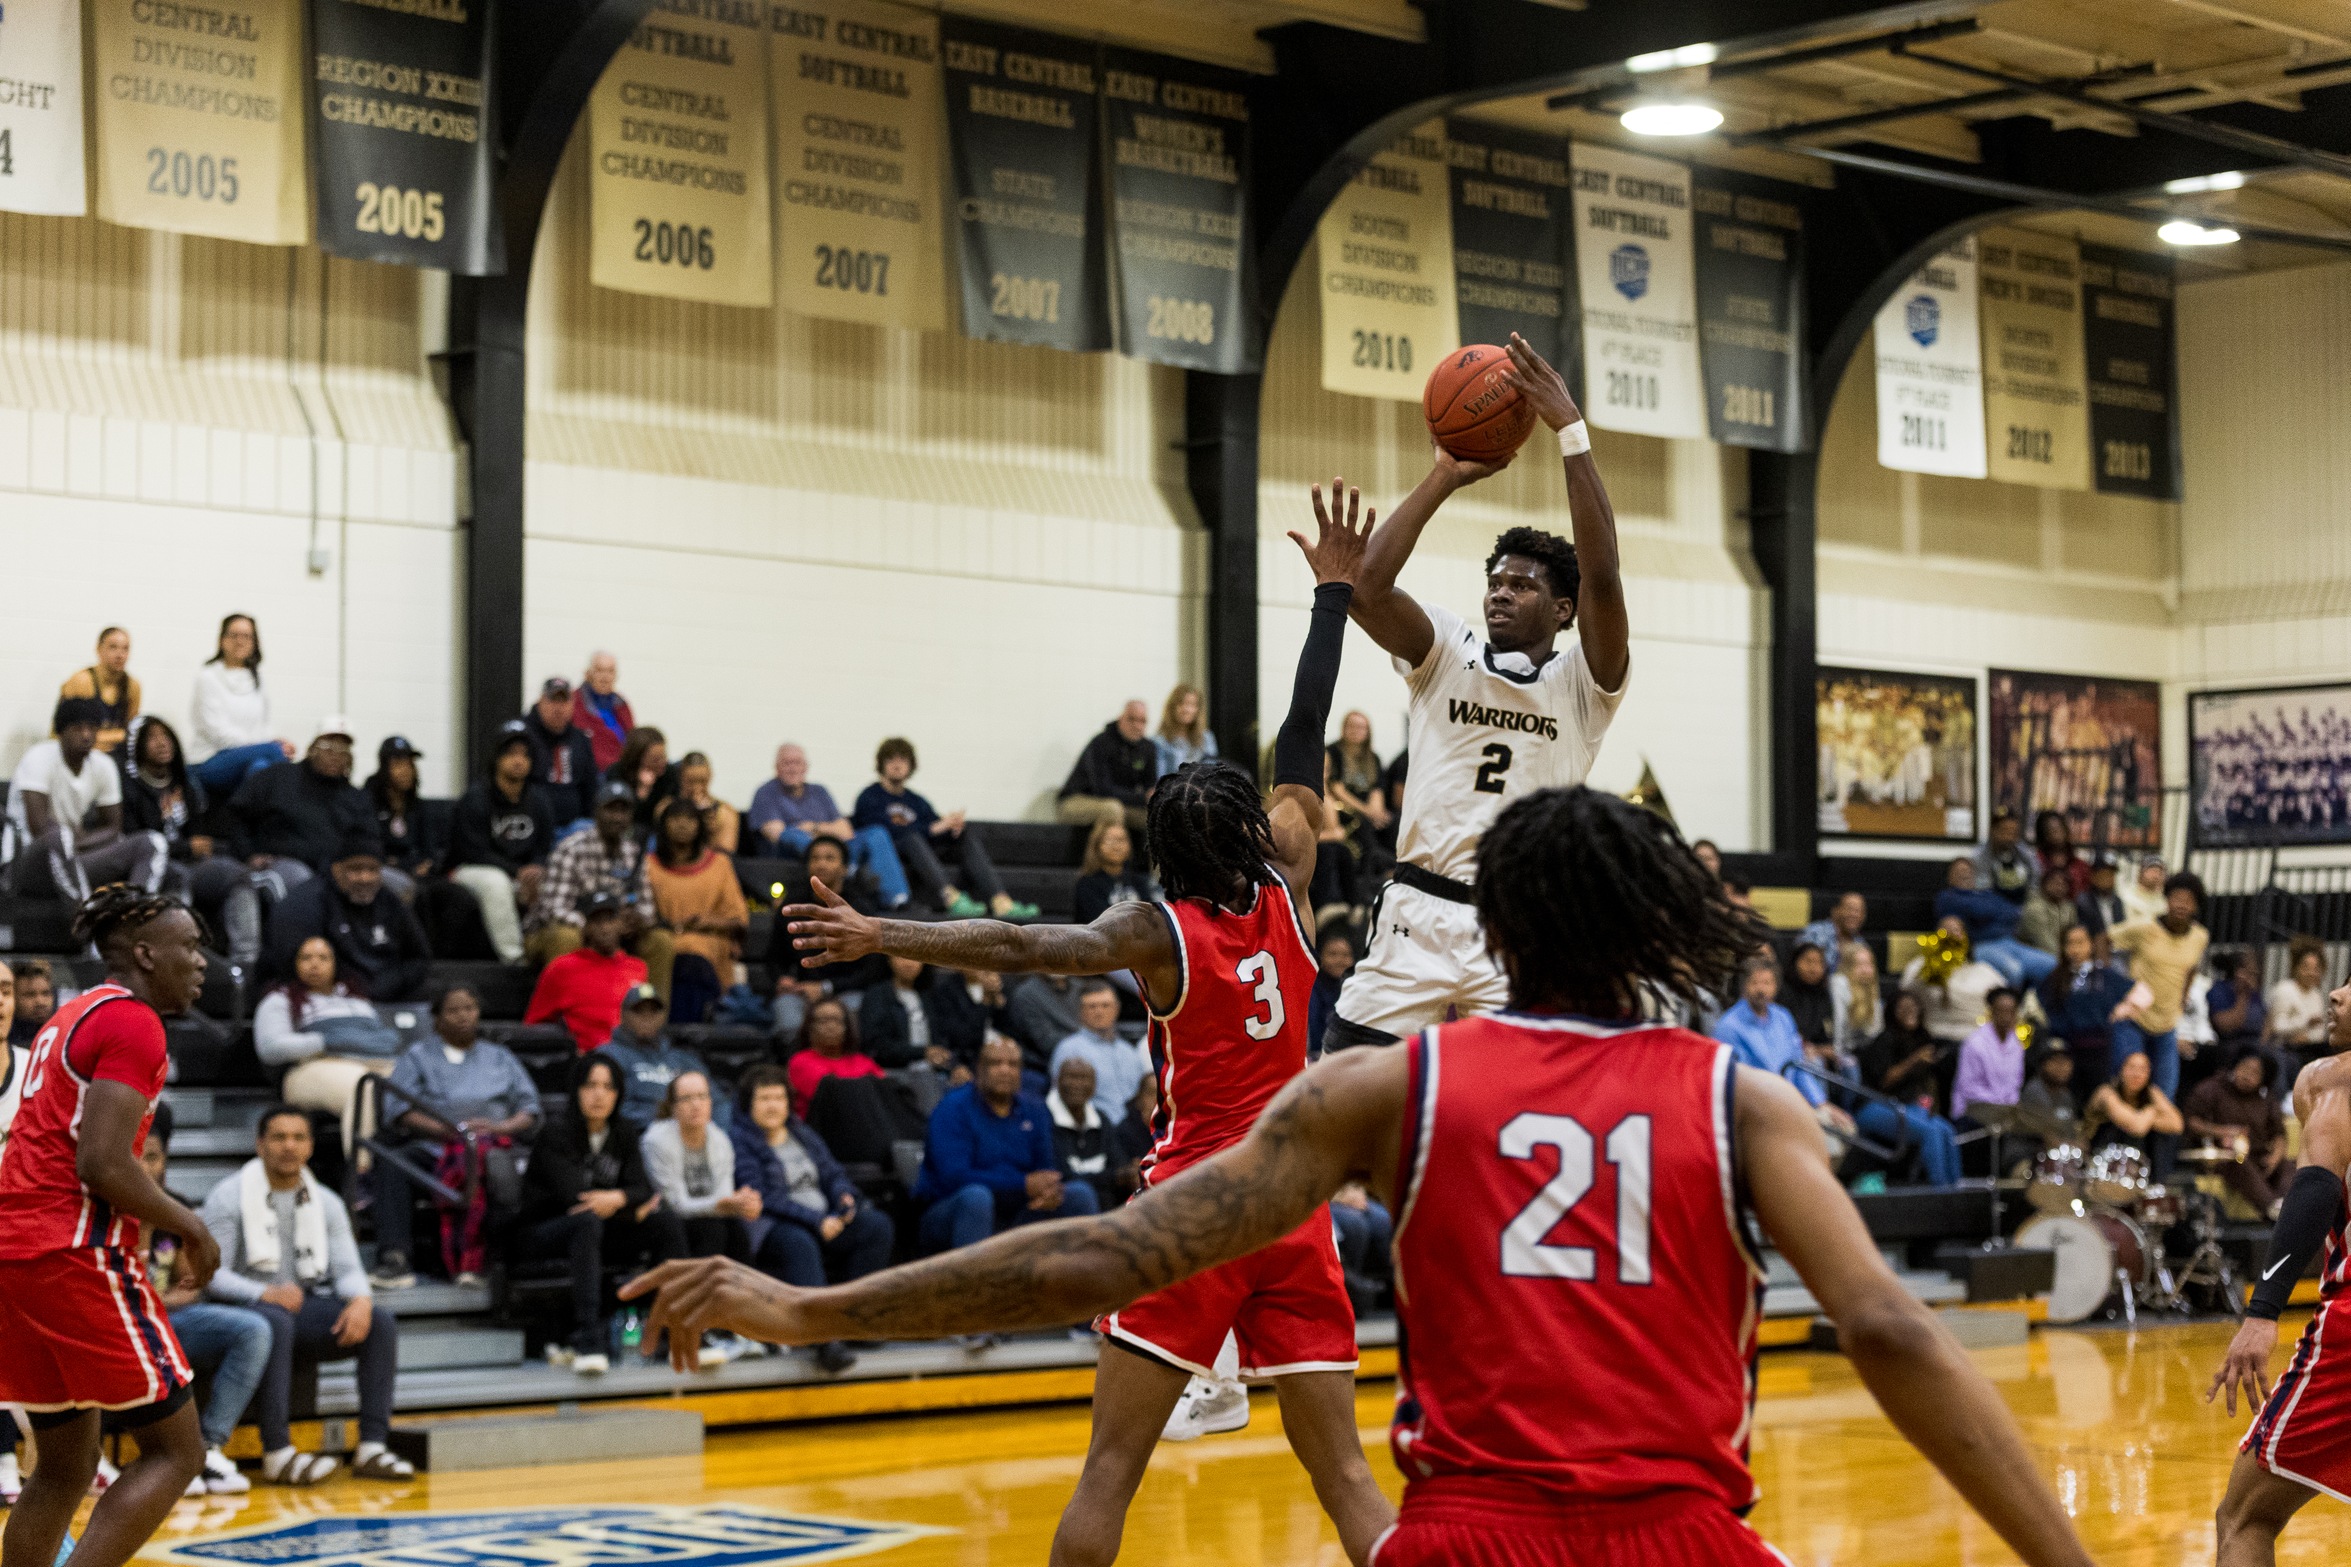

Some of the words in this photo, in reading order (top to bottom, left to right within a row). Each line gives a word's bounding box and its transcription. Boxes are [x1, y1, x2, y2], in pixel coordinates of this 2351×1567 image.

[131, 0, 260, 42] CENTRAL
[772, 7, 828, 41] EAST
[837, 21, 935, 63] CENTRAL
[133, 36, 257, 81] DIVISION
[316, 53, 421, 95] REGION
[799, 53, 911, 99] SOFTBALL
[109, 75, 279, 123] CHAMPIONS
[320, 92, 478, 144] CHAMPIONS
[619, 80, 730, 122] CENTRAL
[620, 116, 729, 156] DIVISION
[803, 113, 905, 153] CENTRAL
[146, 146, 240, 206] 2005
[601, 151, 747, 196] CHAMPIONS
[803, 147, 903, 185] DIVISION
[355, 181, 446, 243] 2005
[784, 178, 922, 224] CHAMPIONS
[634, 218, 715, 271] 2006
[814, 244, 891, 296] 2007
[991, 271, 1061, 325] 2007
[1352, 328, 1413, 374] 2010
[1449, 698, 1558, 741] WARRIORS
[1473, 742, 1513, 795] 2
[1235, 949, 1286, 1042] 3
[1498, 1110, 1653, 1286] 21
